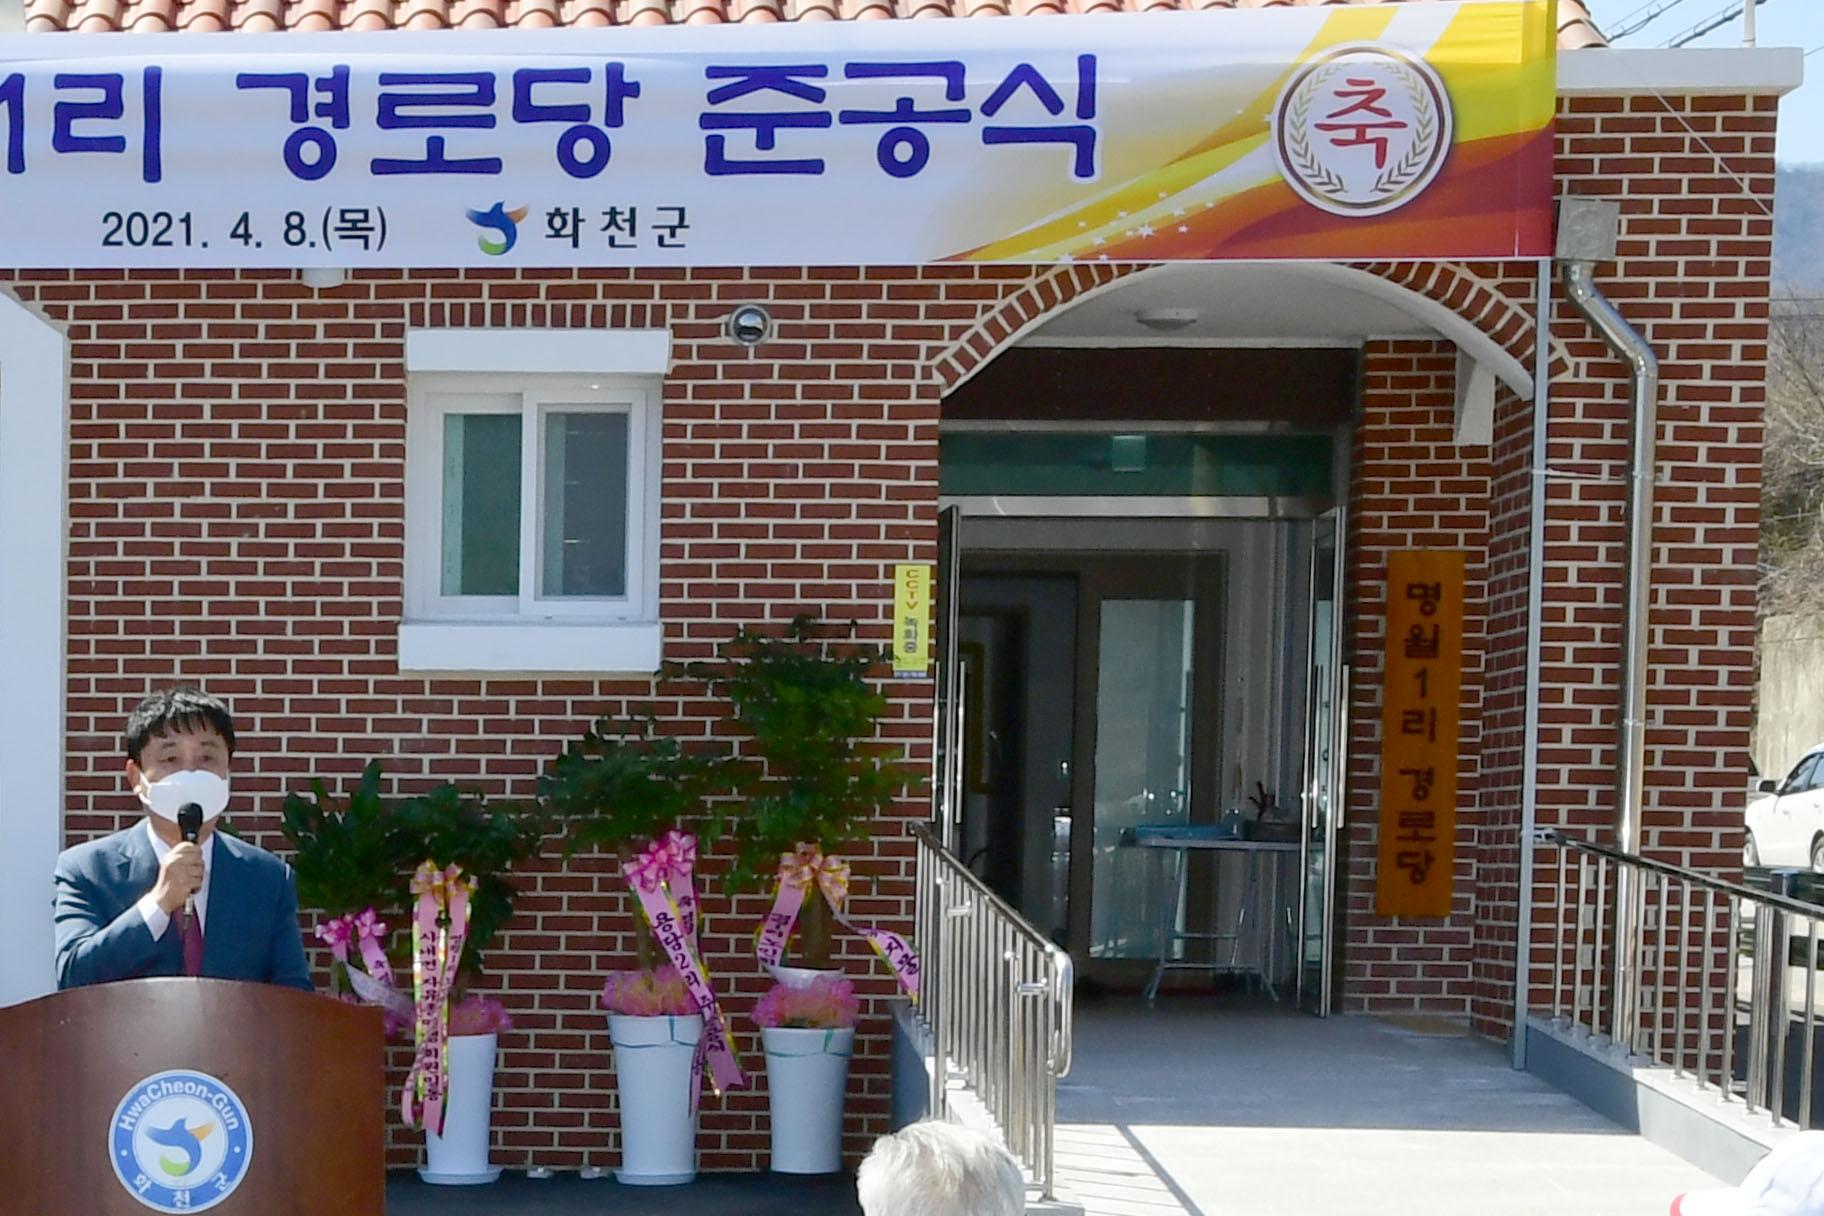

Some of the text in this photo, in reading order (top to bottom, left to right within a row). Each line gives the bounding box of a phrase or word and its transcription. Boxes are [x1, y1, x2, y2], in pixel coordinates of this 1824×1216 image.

[236, 62, 640, 181] 경로당
[700, 54, 1097, 178] 준공식
[1314, 79, 1408, 170] 축
[101, 207, 388, 252] 2021. 4. 8.(목)
[544, 204, 691, 251] 화천군
[905, 569, 919, 610] CCTV
[1395, 581, 1442, 885] 명월1리 경로당
[118, 1079, 240, 1132] HwaCheon-Gun
